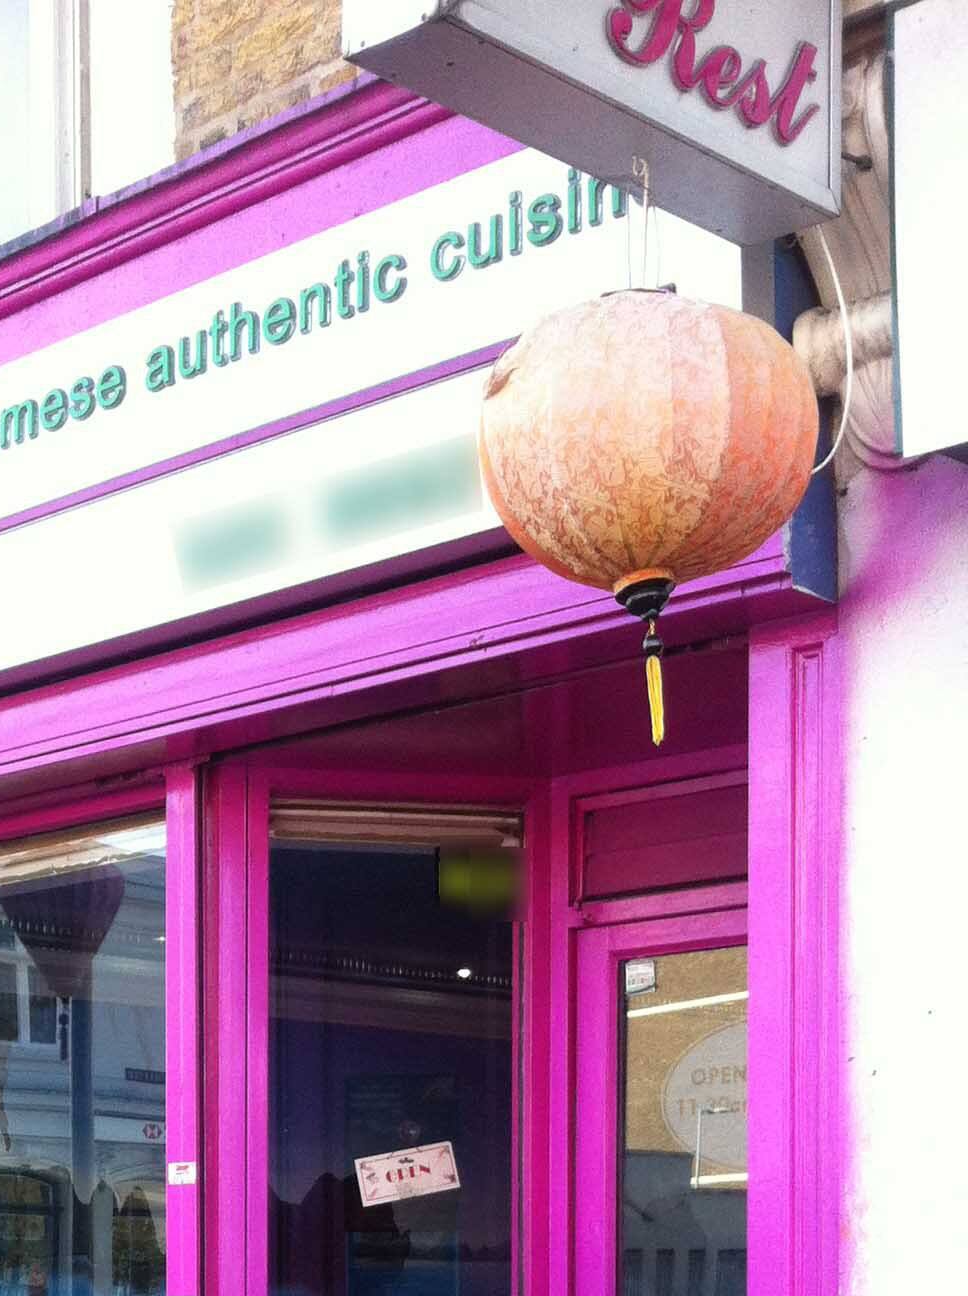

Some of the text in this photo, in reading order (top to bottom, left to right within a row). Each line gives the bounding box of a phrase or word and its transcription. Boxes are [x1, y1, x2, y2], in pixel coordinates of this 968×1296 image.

[605, 0, 820, 146] Rest
[144, 250, 408, 393] authentic
[430, 166, 646, 282] cuisin
